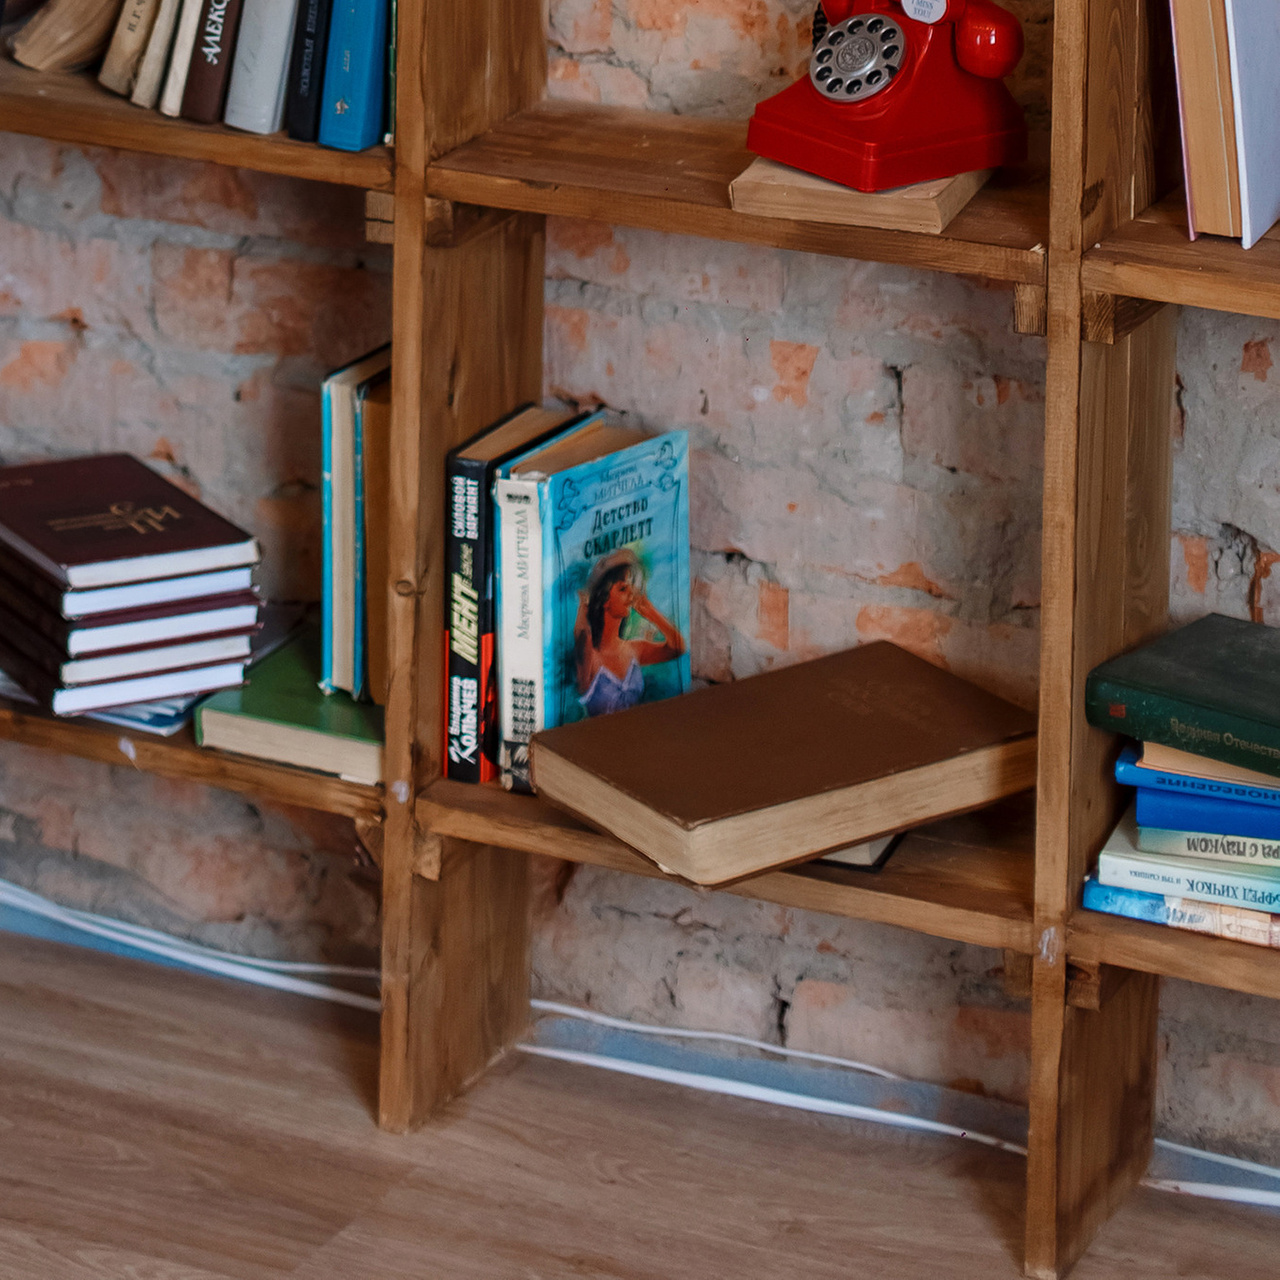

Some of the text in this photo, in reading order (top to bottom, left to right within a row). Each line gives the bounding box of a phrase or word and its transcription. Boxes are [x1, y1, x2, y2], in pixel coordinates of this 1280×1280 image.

[300, 38, 314, 96] ЗОЛОТАЯ
[452, 475, 479, 540] СИЛОВОЙ ВАРИАНТ
[592, 475, 647, 504] МИТЧЕЛЛ
[592, 497, 649, 531] Детство
[583, 517, 655, 560] СКАРЛЕТТ
[448, 676, 479, 765] КОЛЫЧЕВ
[1160, 874, 1176, 884] ТРИ
[1186, 877, 1239, 900] ХИЧКОК
